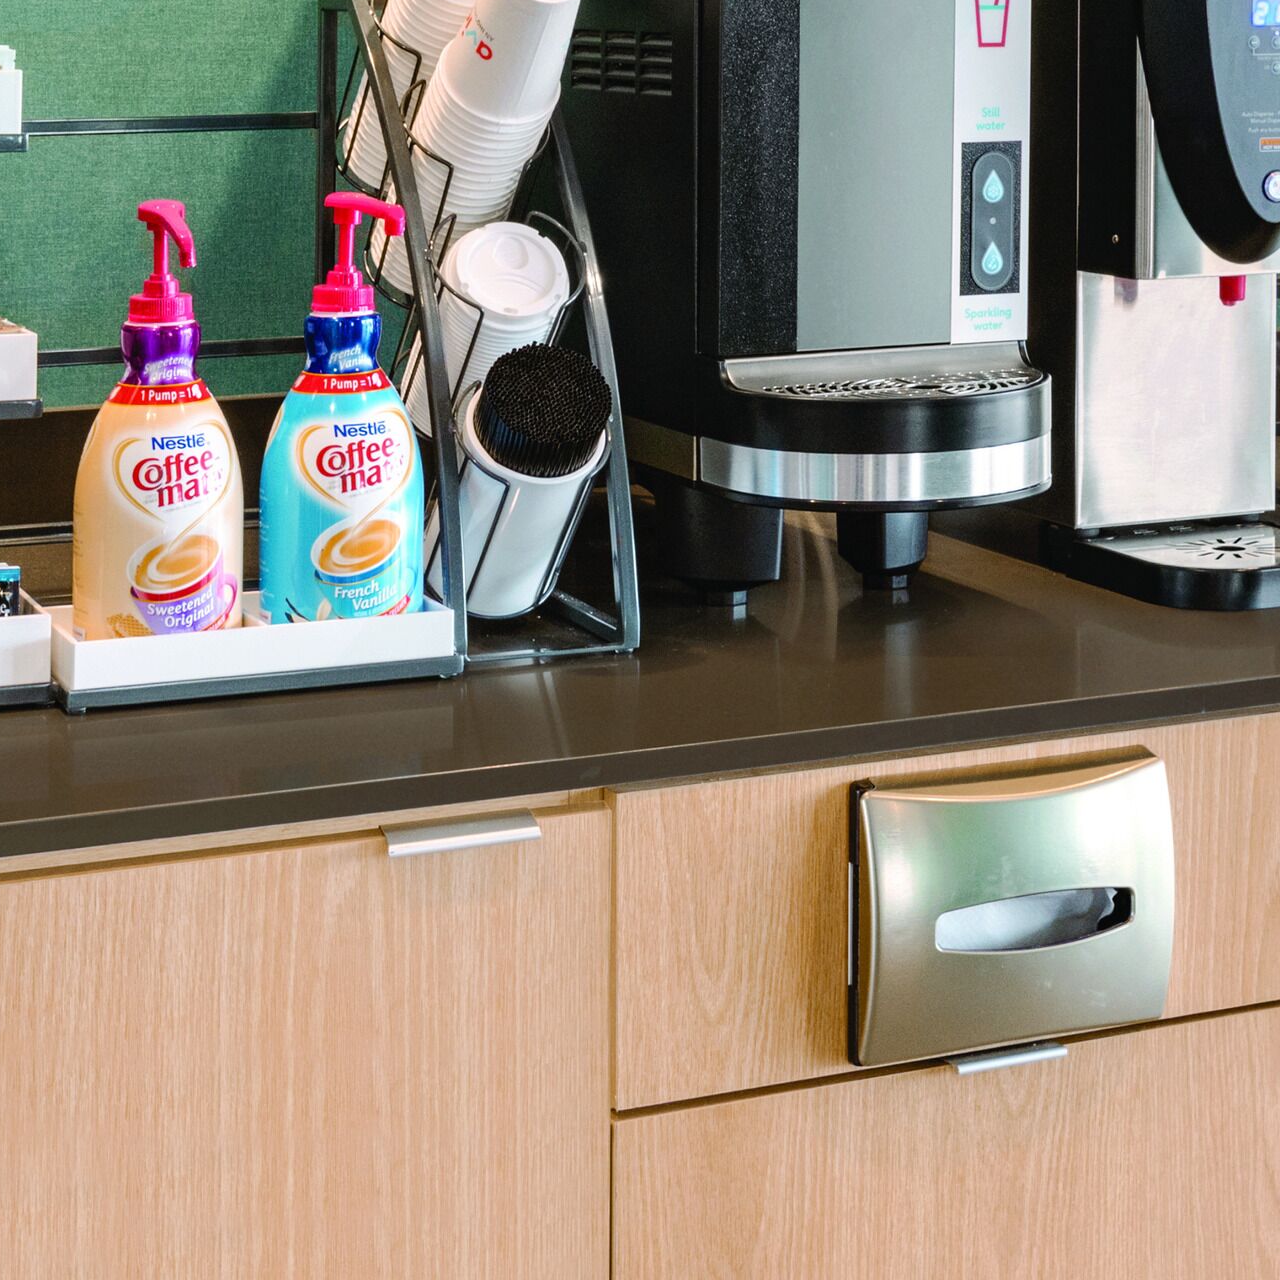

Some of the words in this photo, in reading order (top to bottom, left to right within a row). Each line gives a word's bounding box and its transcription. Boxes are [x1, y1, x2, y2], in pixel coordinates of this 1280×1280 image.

[982, 107, 1000, 118] Still
[976, 120, 1006, 131] water
[964, 307, 1013, 320] Sparkling
[973, 320, 1004, 331] water
[330, 378, 359, 391] Pump
[148, 389, 177, 404] Pump
[334, 580, 379, 599] French
[147, 584, 213, 615] Sweetened
[164, 598, 215, 628] Original
